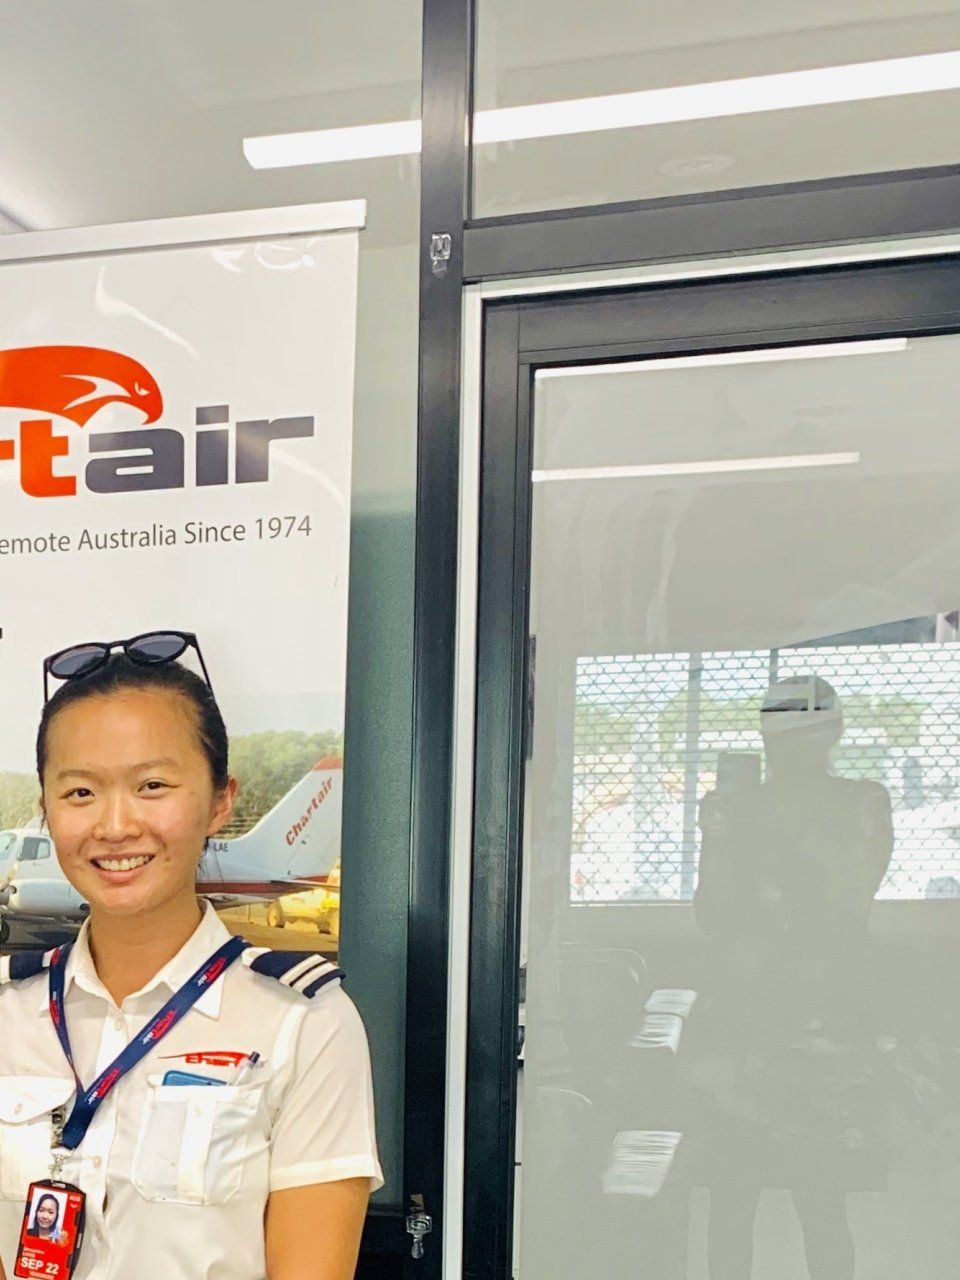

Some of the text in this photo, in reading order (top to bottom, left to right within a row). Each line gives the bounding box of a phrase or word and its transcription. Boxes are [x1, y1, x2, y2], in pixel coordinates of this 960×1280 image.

[77, 523, 176, 550] Australia
[184, 521, 245, 544] Since
[252, 515, 311, 539] 1974
[21, 1257, 59, 1275] SEP 22
